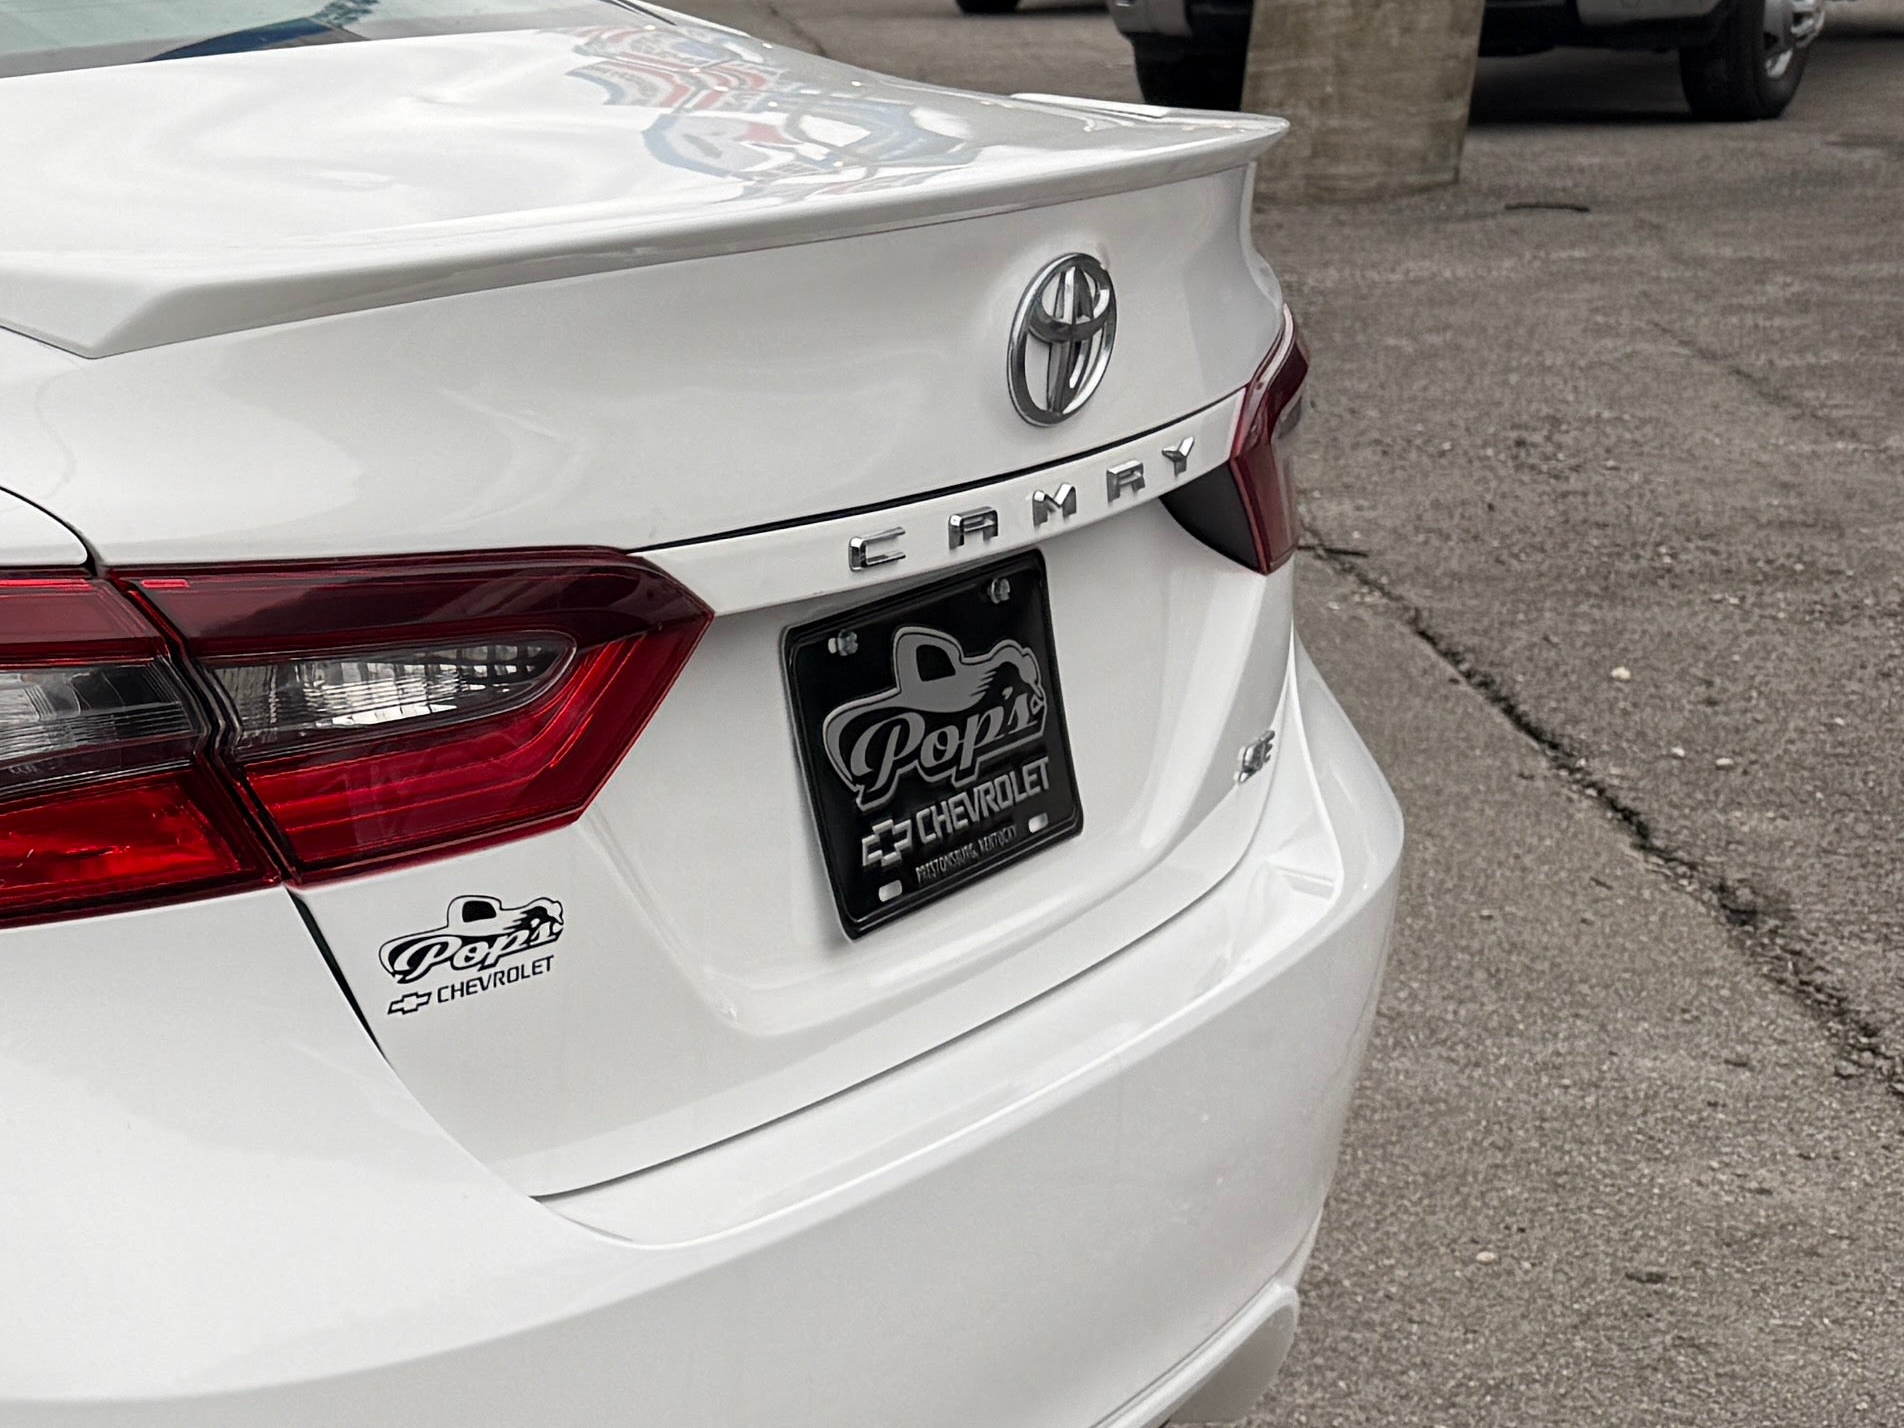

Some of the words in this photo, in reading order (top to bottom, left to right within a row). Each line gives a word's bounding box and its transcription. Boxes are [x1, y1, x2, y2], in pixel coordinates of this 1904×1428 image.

[848, 435, 1196, 573] CAMRY
[850, 686, 1041, 794] Pop's
[915, 755, 1050, 845] CHEVROLET
[392, 918, 560, 984] Pop's
[436, 954, 555, 1004] CHEVROLET
